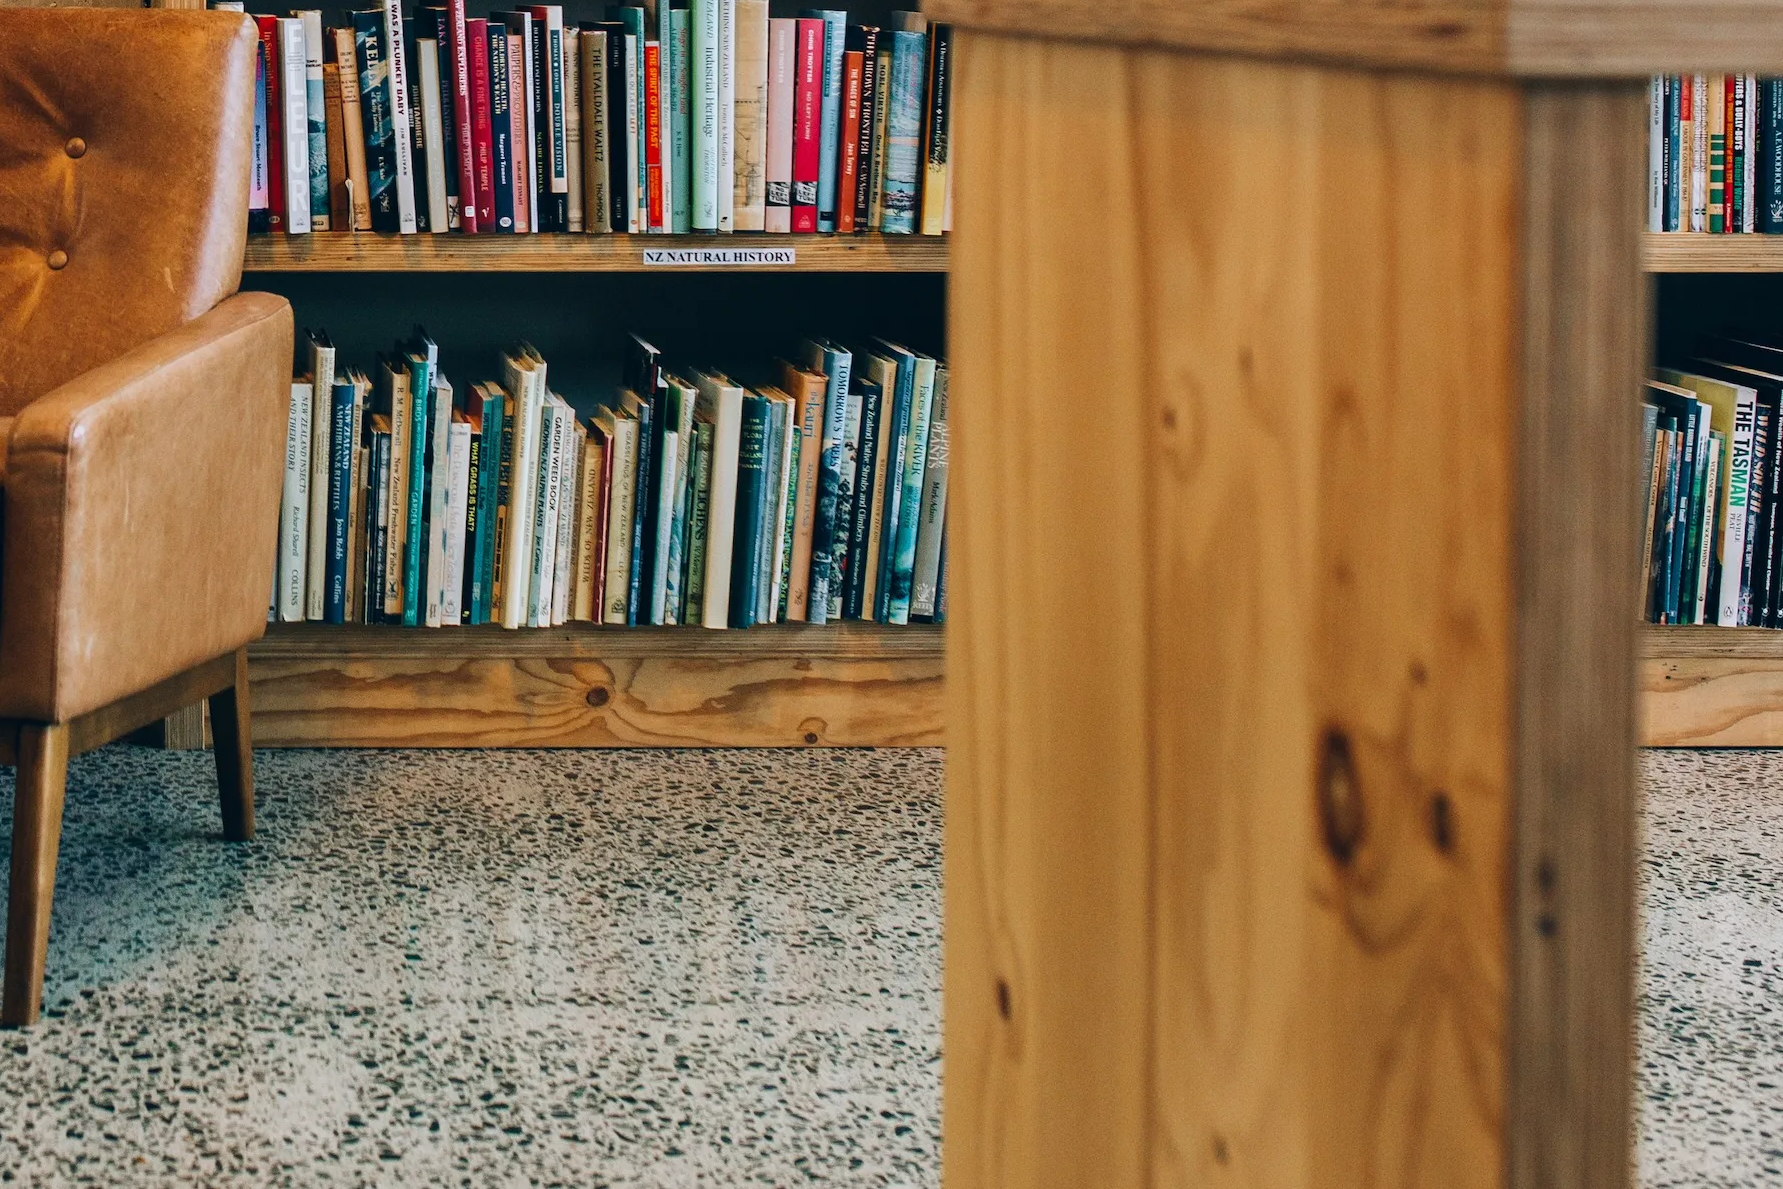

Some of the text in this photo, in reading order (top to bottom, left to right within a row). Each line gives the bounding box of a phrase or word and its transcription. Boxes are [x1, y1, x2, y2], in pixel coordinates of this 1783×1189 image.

[591, 48, 604, 162] THE LYALLDALE WALTZ
[703, 47, 716, 138] Industrial Heritage
[876, 63, 886, 124] NOEL VIRTUE
[645, 252, 793, 262] NZ NATURAL HISTORY
[829, 363, 849, 468] TOMORROW'S TREES
[469, 467, 478, 494] GRASS
[470, 441, 480, 465] WHAT
[548, 416, 563, 512] GARDEN WEED BOOK
[1729, 401, 1754, 506] THE TASMAN
[467, 505, 477, 532] THAT?
[695, 488, 709, 540] LICHENS
